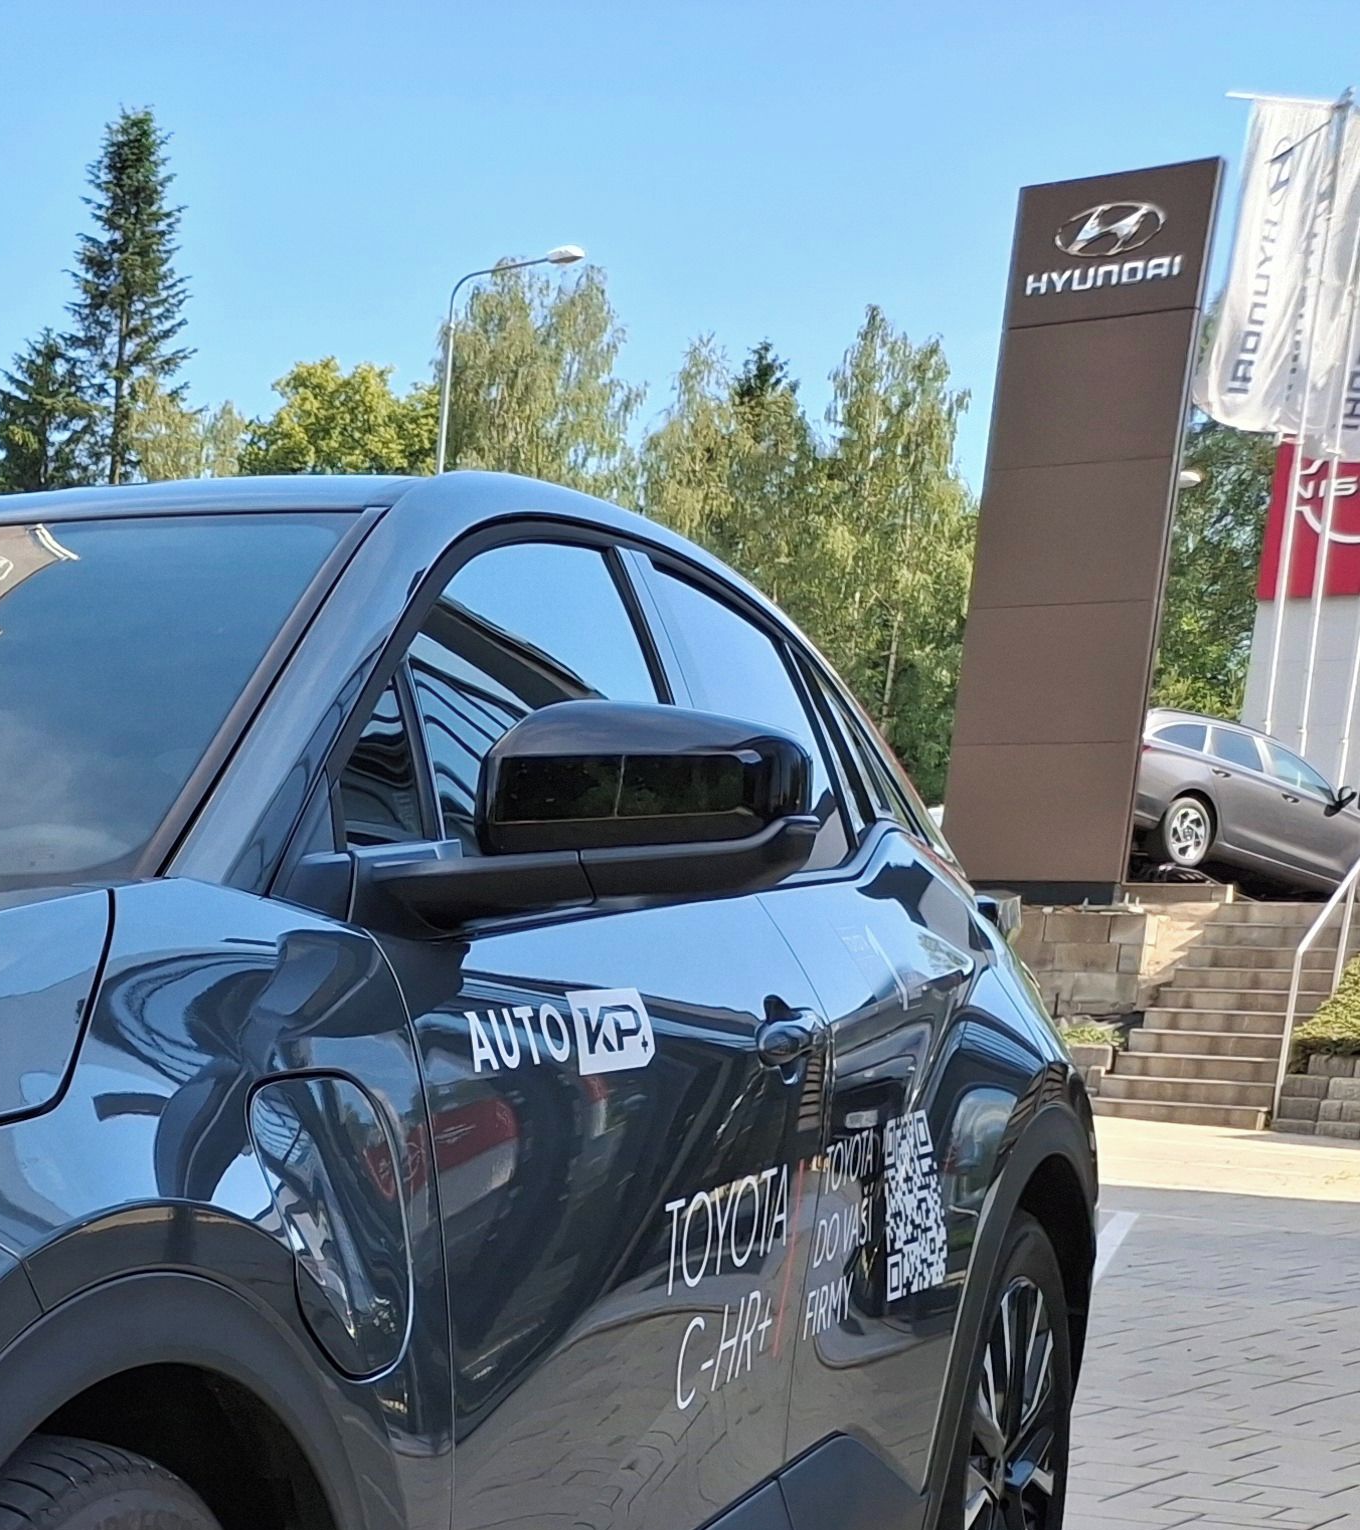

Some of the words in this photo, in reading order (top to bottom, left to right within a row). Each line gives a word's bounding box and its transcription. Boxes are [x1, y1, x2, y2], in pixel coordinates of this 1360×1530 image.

[1025, 254, 1183, 297] HYUNDAI
[463, 1003, 570, 1073] AUTO
[824, 1128, 875, 1195] TOYOTA
[665, 1163, 788, 1296] TOYOTA
[813, 1212, 840, 1268] DO
[842, 1184, 874, 1252] VAŠÍ
[802, 1273, 854, 1341] FIRMY
[676, 1290, 772, 1410] C-HR+
